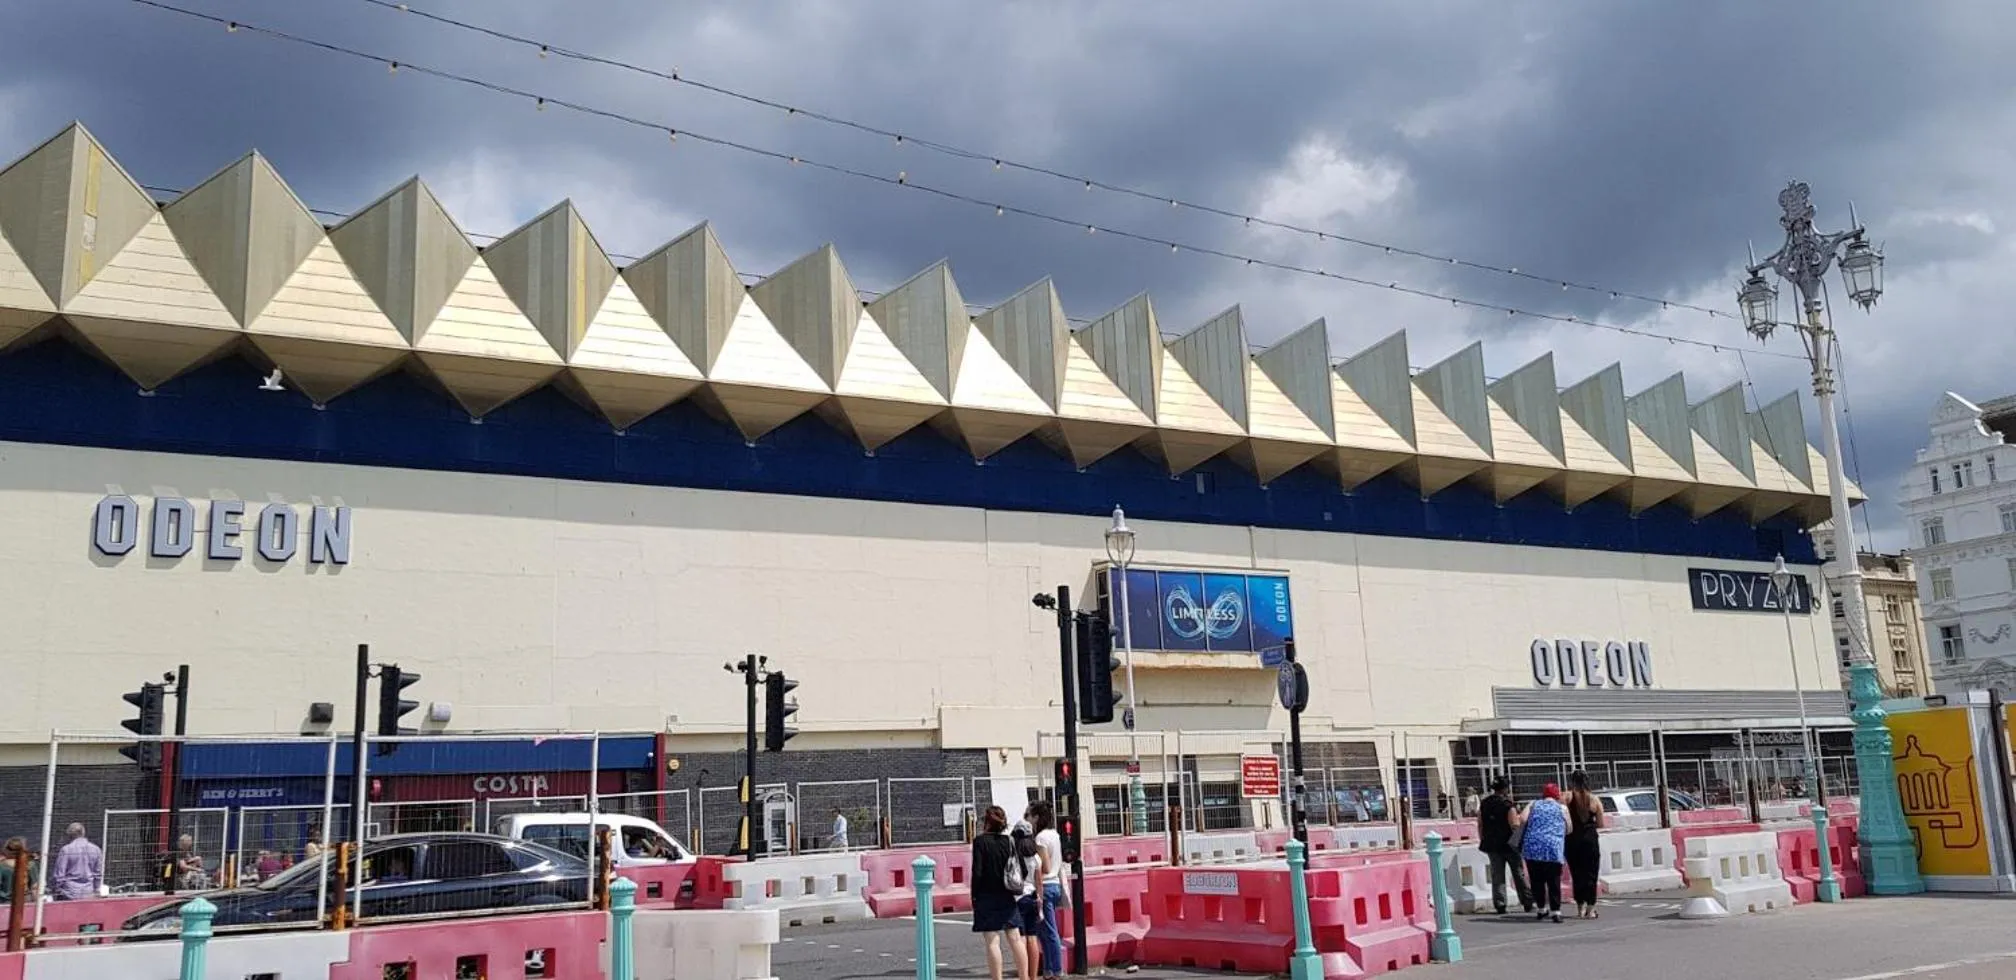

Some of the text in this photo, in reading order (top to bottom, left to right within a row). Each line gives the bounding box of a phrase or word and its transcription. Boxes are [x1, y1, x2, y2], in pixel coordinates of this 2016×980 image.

[94, 494, 352, 565] ODEON
[1275, 582, 1288, 622] ODEON
[1700, 572, 1801, 610] PRYZM
[1172, 607, 1236, 621] LIMITLESS
[1531, 639, 1653, 686] ODEON
[203, 787, 284, 799] BEN & JERRY'S
[473, 775, 549, 794] COSTA
